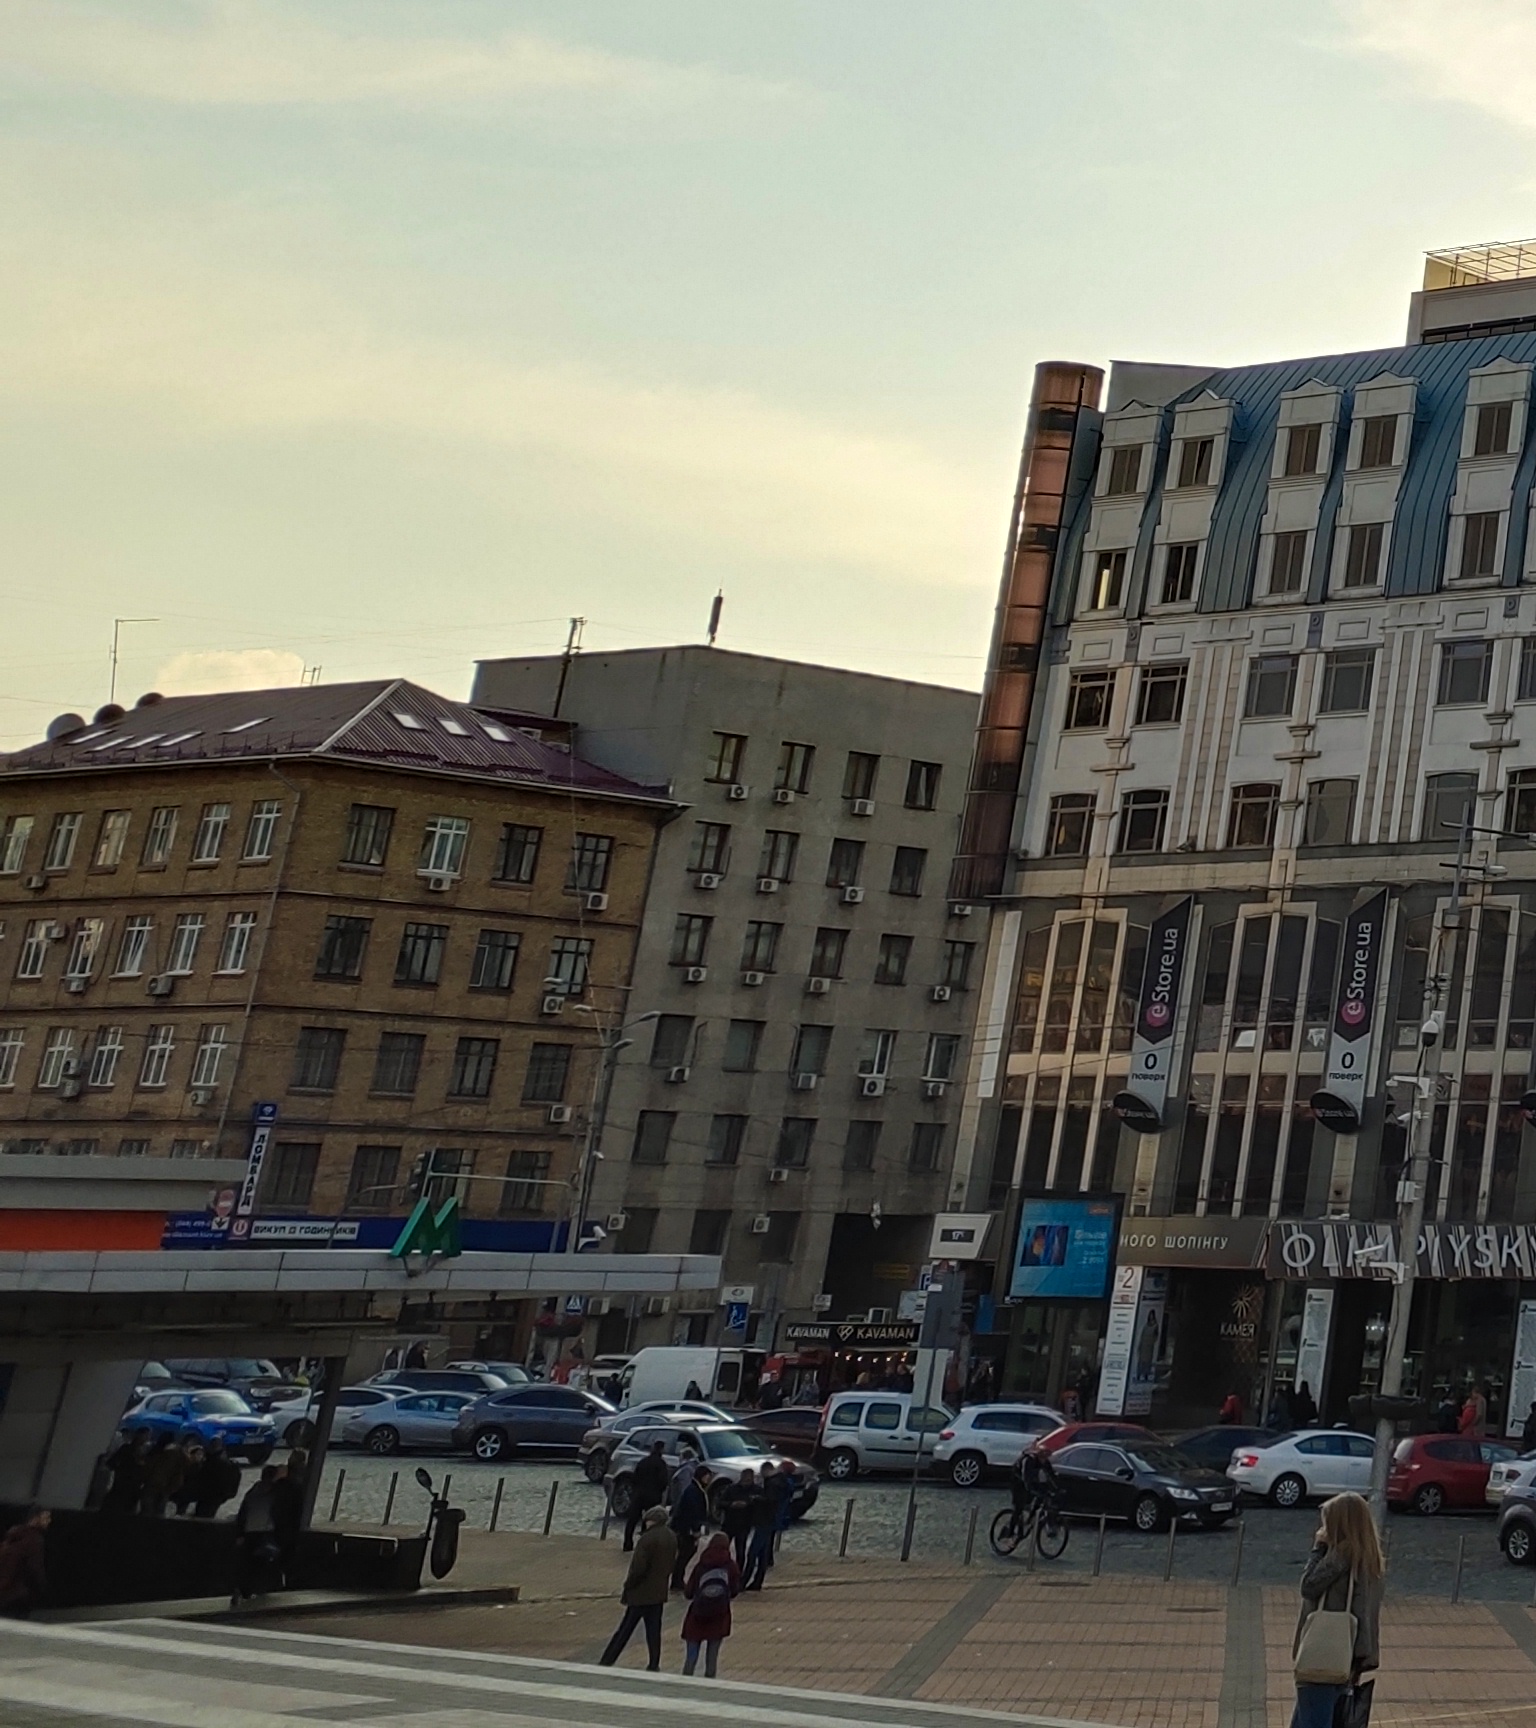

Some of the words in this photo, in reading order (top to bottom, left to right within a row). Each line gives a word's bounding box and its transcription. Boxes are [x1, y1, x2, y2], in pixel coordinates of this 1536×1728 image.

[1144, 1053, 1157, 1070] 0
[1341, 1052, 1354, 1069] 0
[241, 1134, 267, 1207] ЛОМБАРД
[299, 1226, 356, 1235] ГОДИНИКІВ
[1164, 1235, 1229, 1250] ШОПІНГУ
[786, 1327, 830, 1340] KAVAMAN
[856, 1328, 915, 1341] KAVAMAN
[1220, 1321, 1256, 1337] КАМЕЯ
